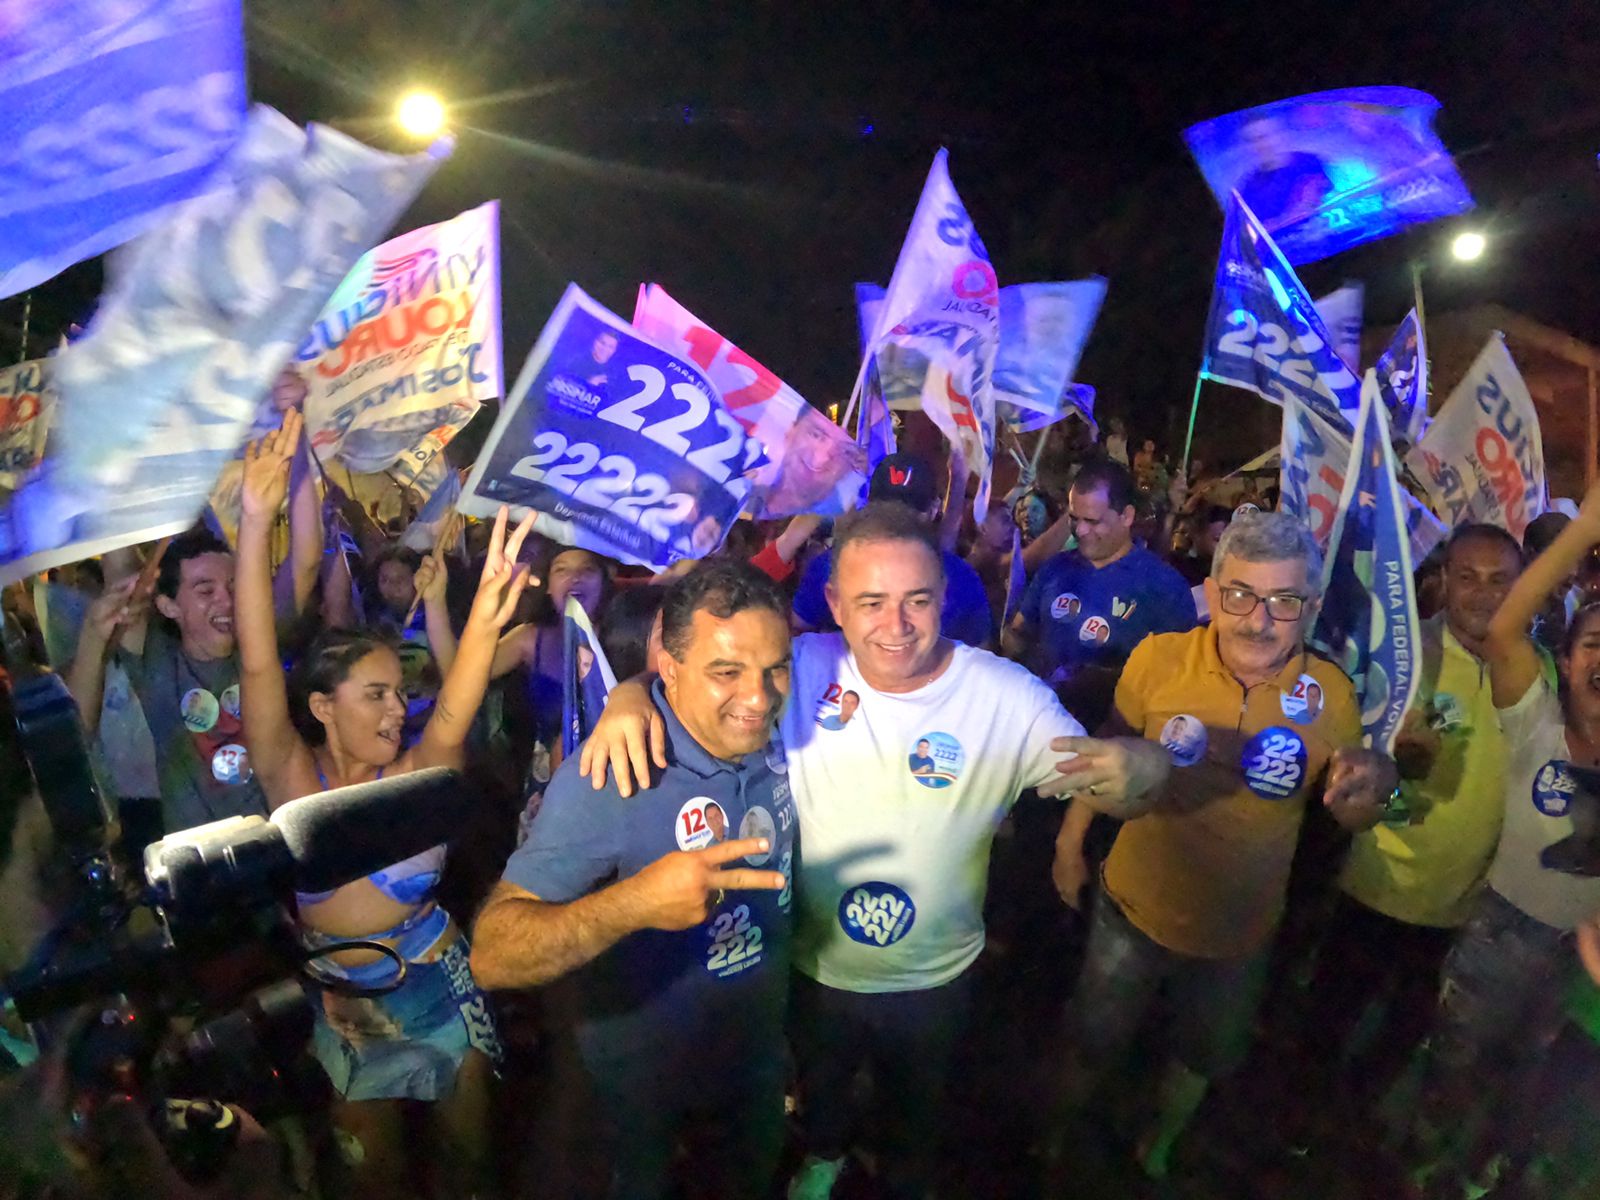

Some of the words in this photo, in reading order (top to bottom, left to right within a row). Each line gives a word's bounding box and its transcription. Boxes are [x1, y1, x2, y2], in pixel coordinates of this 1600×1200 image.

[511, 431, 696, 543] 22222
[1057, 597, 1070, 609] 12
[1384, 561, 1403, 610] PARA
[1086, 618, 1100, 633] 12
[1391, 614, 1410, 696] FEDERAL
[822, 683, 843, 705] 12
[682, 807, 706, 836] 12
[706, 926, 764, 972] 222
